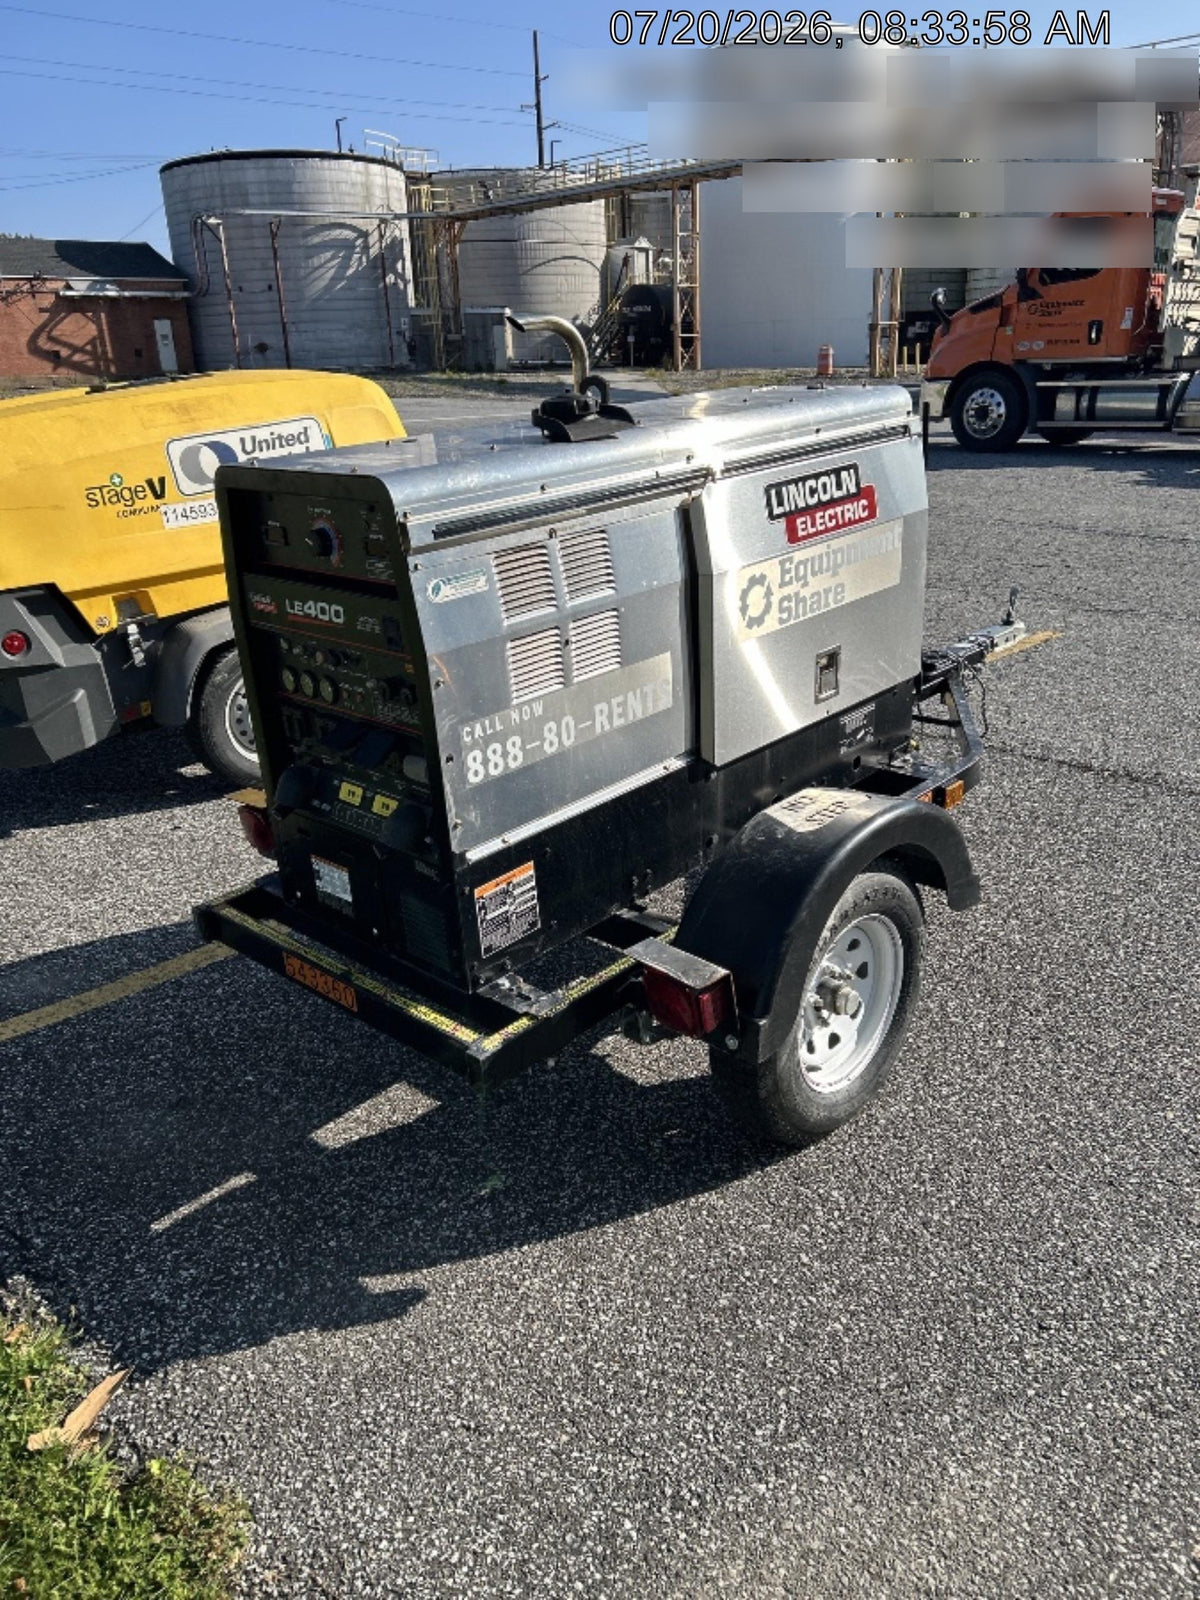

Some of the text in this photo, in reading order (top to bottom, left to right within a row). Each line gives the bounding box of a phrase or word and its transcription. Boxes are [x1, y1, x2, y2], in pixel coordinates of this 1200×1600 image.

[239, 426, 311, 456] United
[768, 467, 858, 516] LINCOLN
[796, 499, 869, 539] ELECTRIC
[285, 598, 345, 625] LE400
[777, 581, 846, 627] Share
[462, 700, 545, 743] CALL NOW
